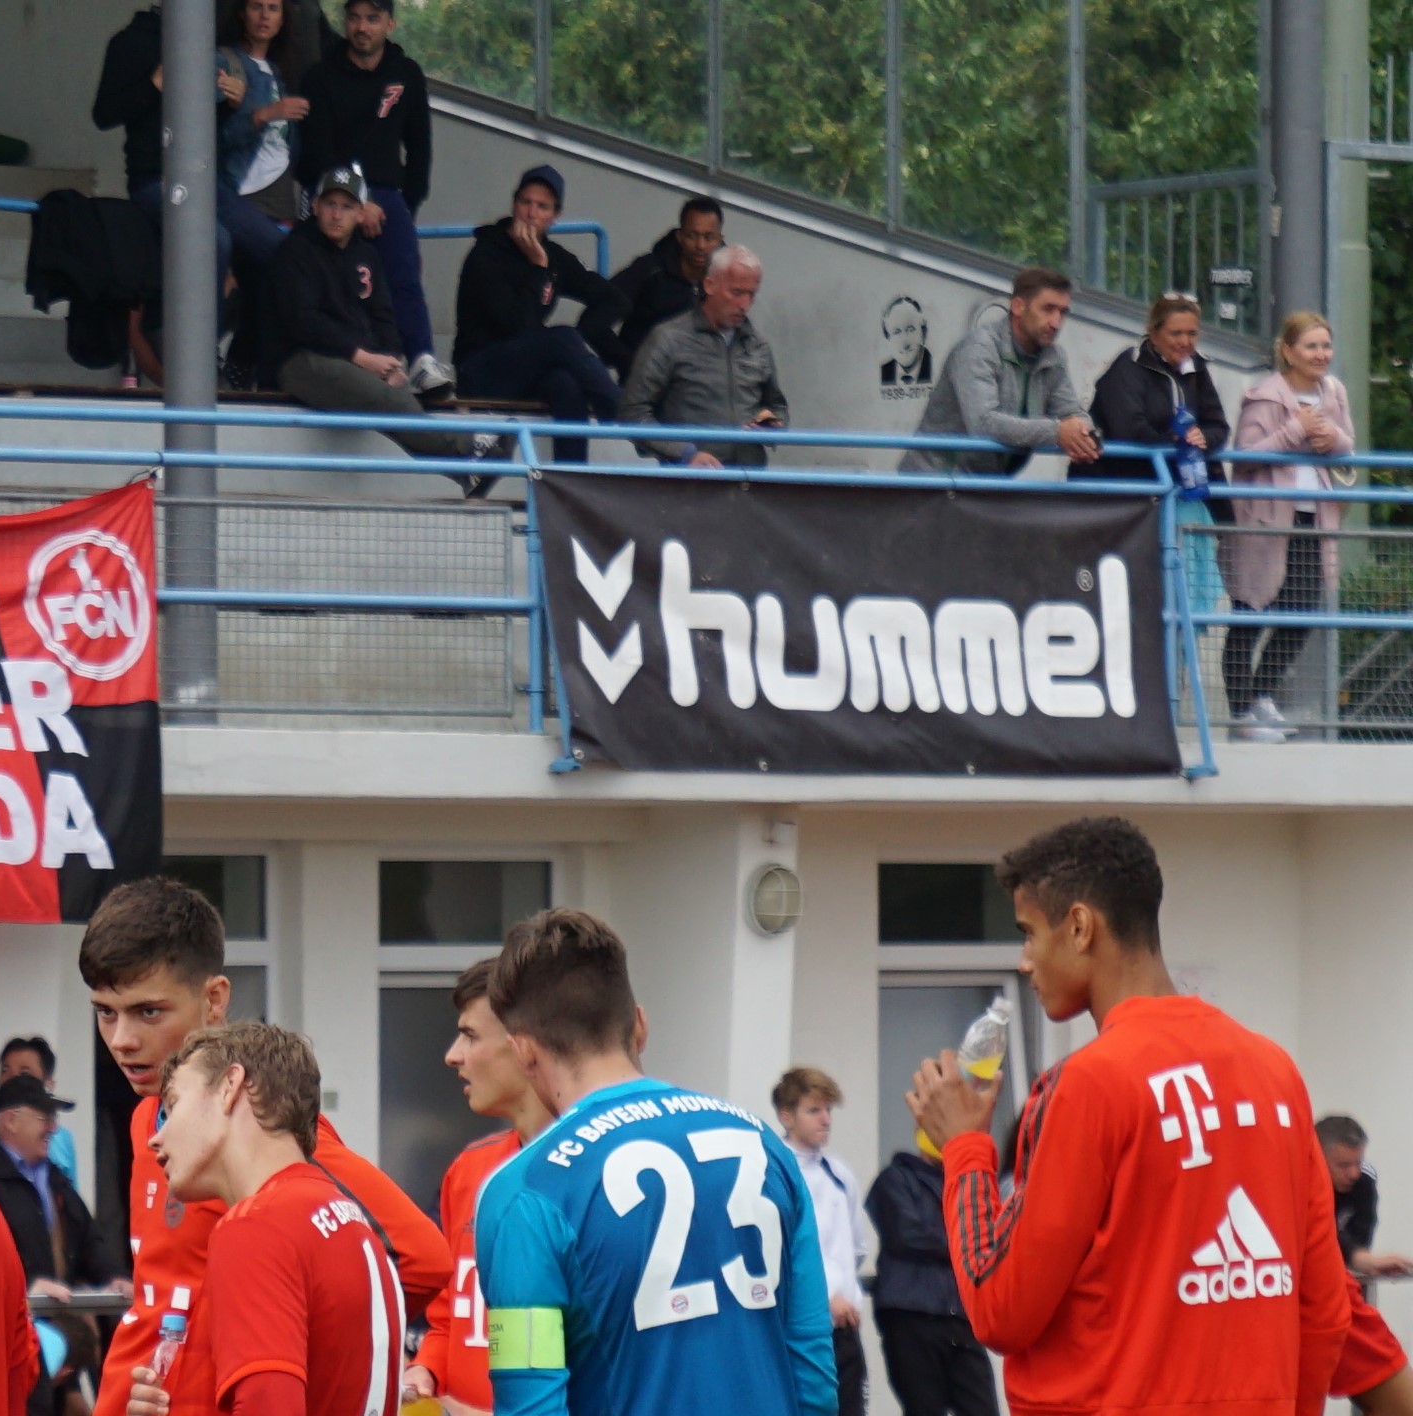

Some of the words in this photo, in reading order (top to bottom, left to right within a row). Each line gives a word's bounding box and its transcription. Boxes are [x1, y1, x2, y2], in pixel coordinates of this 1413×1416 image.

[42, 589, 137, 642] FCN
[659, 537, 1137, 719] hummel
[547, 1140, 584, 1168] FC
[575, 1099, 663, 1143] BAYERN
[311, 1208, 338, 1239] FC
[602, 1128, 783, 1332] 23
